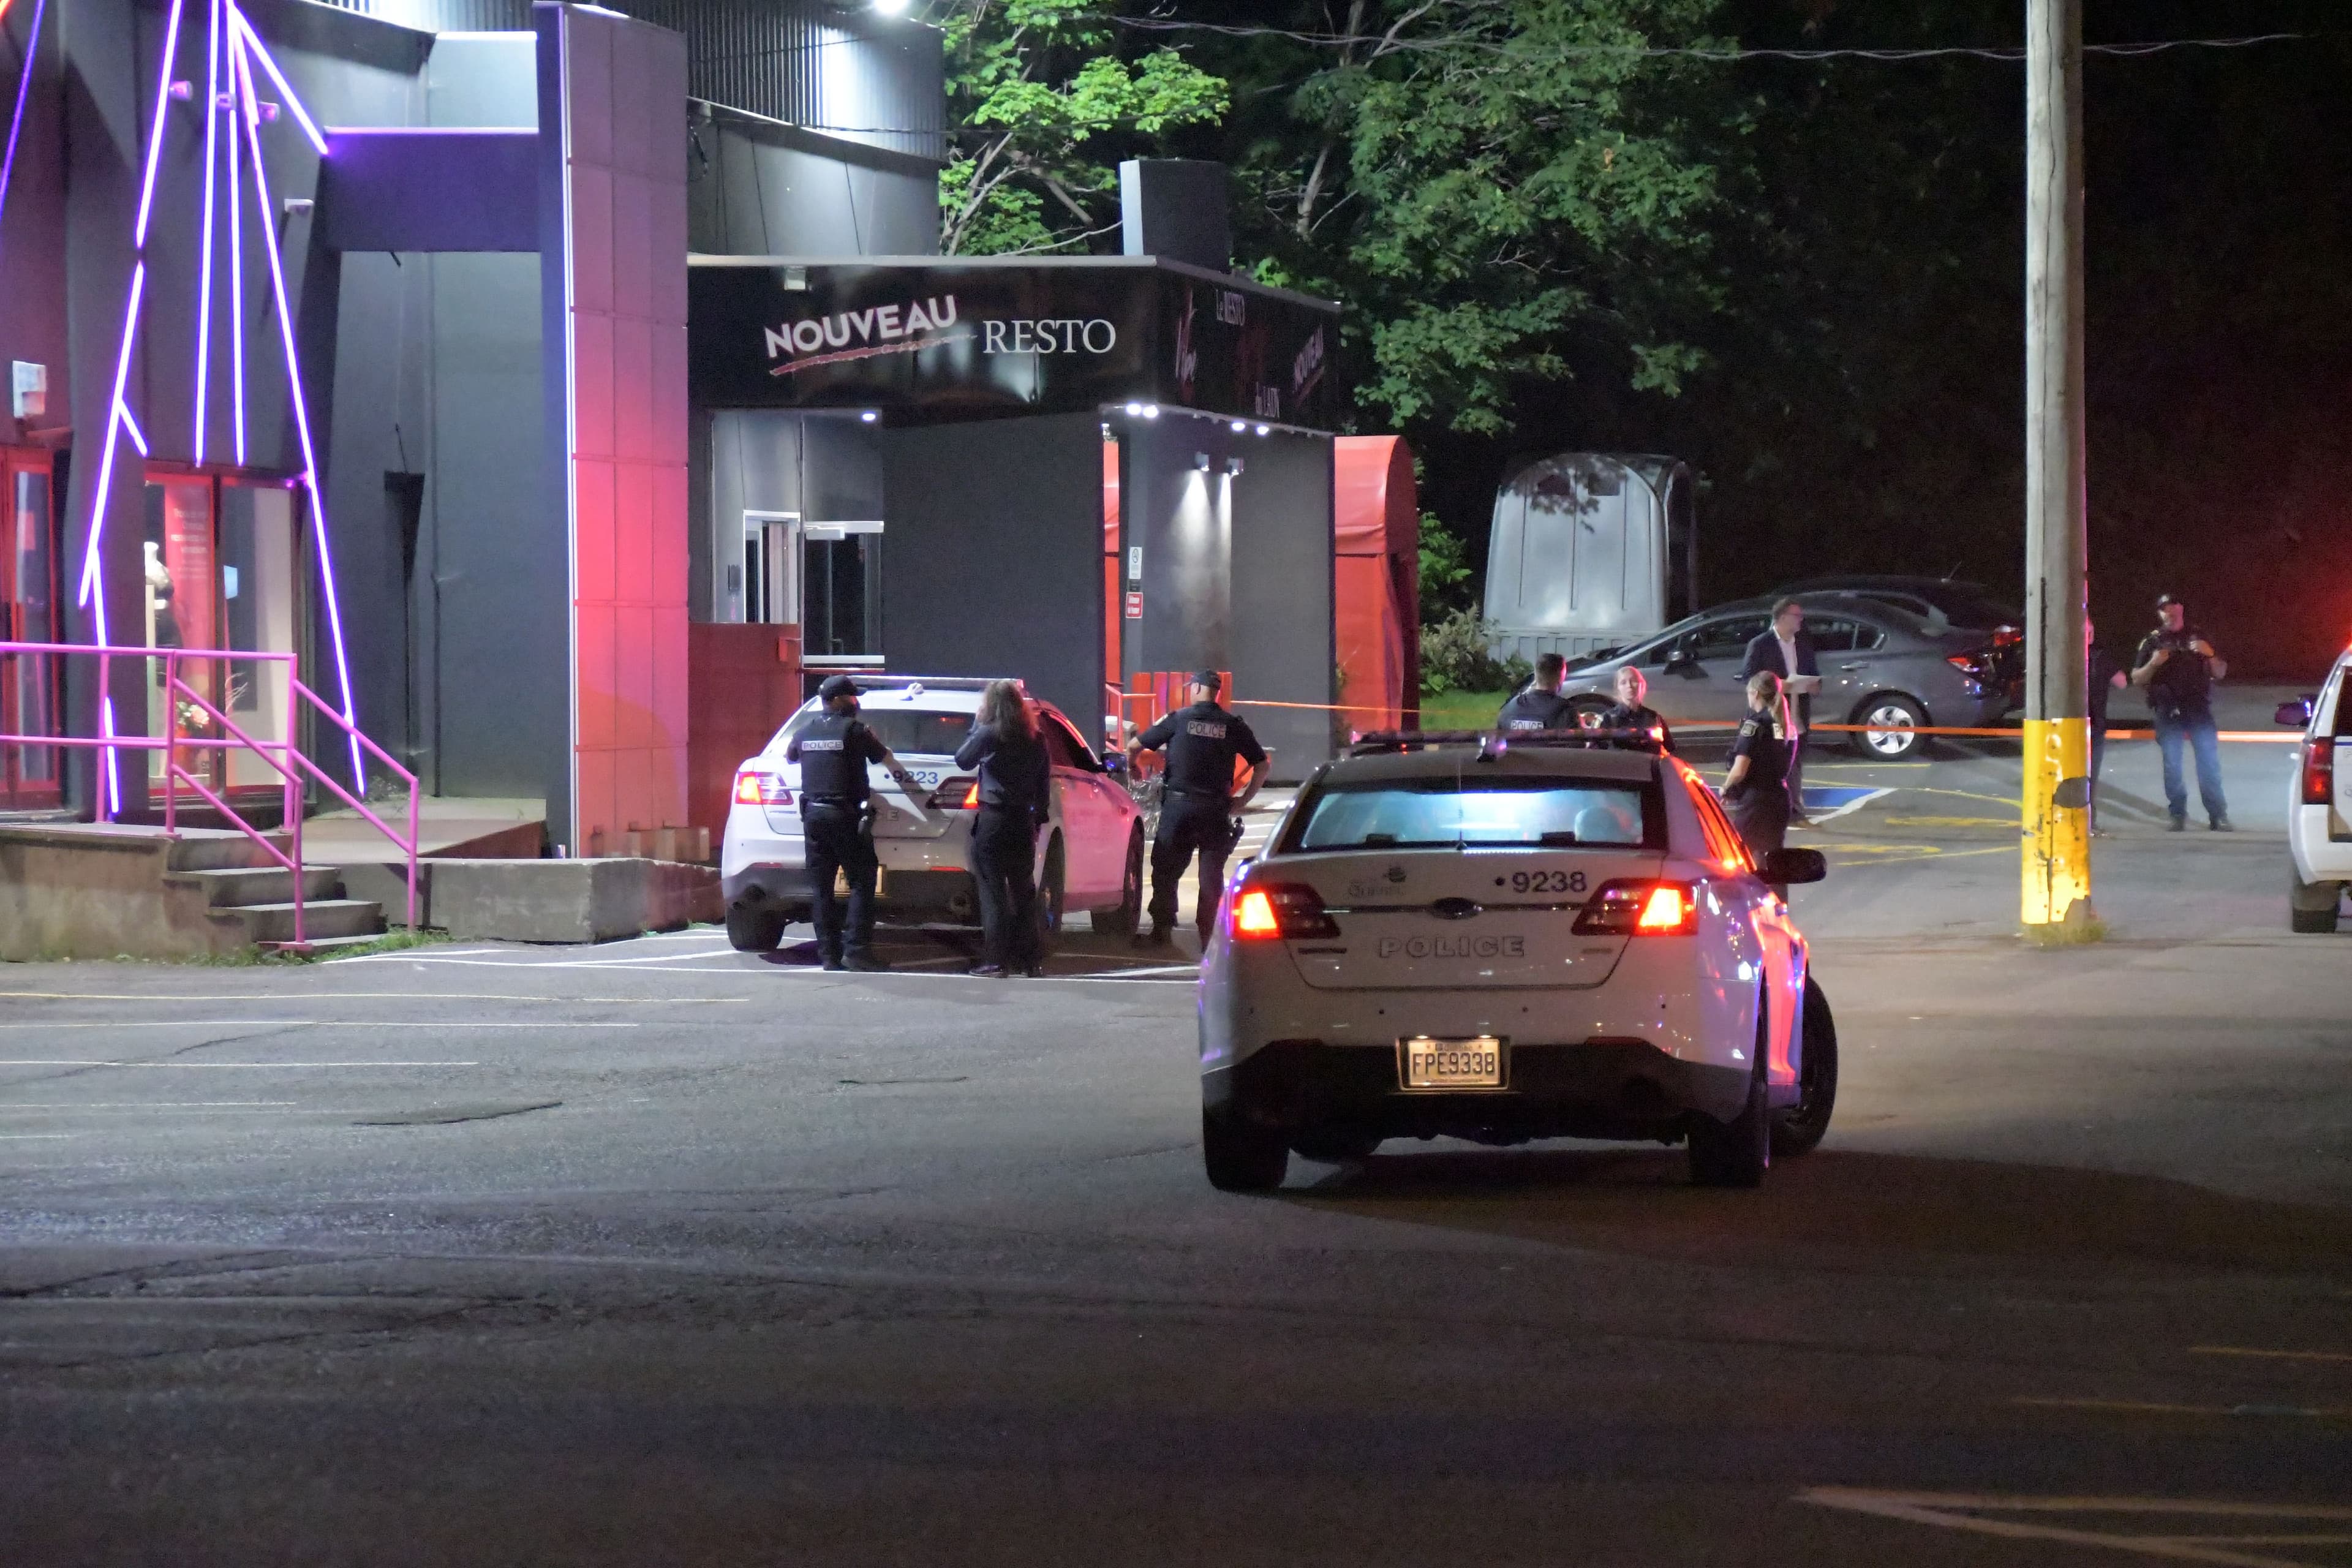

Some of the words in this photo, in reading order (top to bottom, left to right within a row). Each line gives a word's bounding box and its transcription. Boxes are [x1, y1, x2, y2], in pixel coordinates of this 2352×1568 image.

[764, 295, 957, 358] NOUVEAU
[983, 319, 1116, 354] RESTO
[1189, 722, 1226, 737] POLICE
[1511, 720, 1544, 729] POLICE
[802, 741, 843, 750] POLICE
[892, 770, 938, 785] 9223
[1512, 871, 1588, 894] 9238
[1379, 935, 1525, 959] POLICE
[1412, 1052, 1495, 1075] FPE9338
